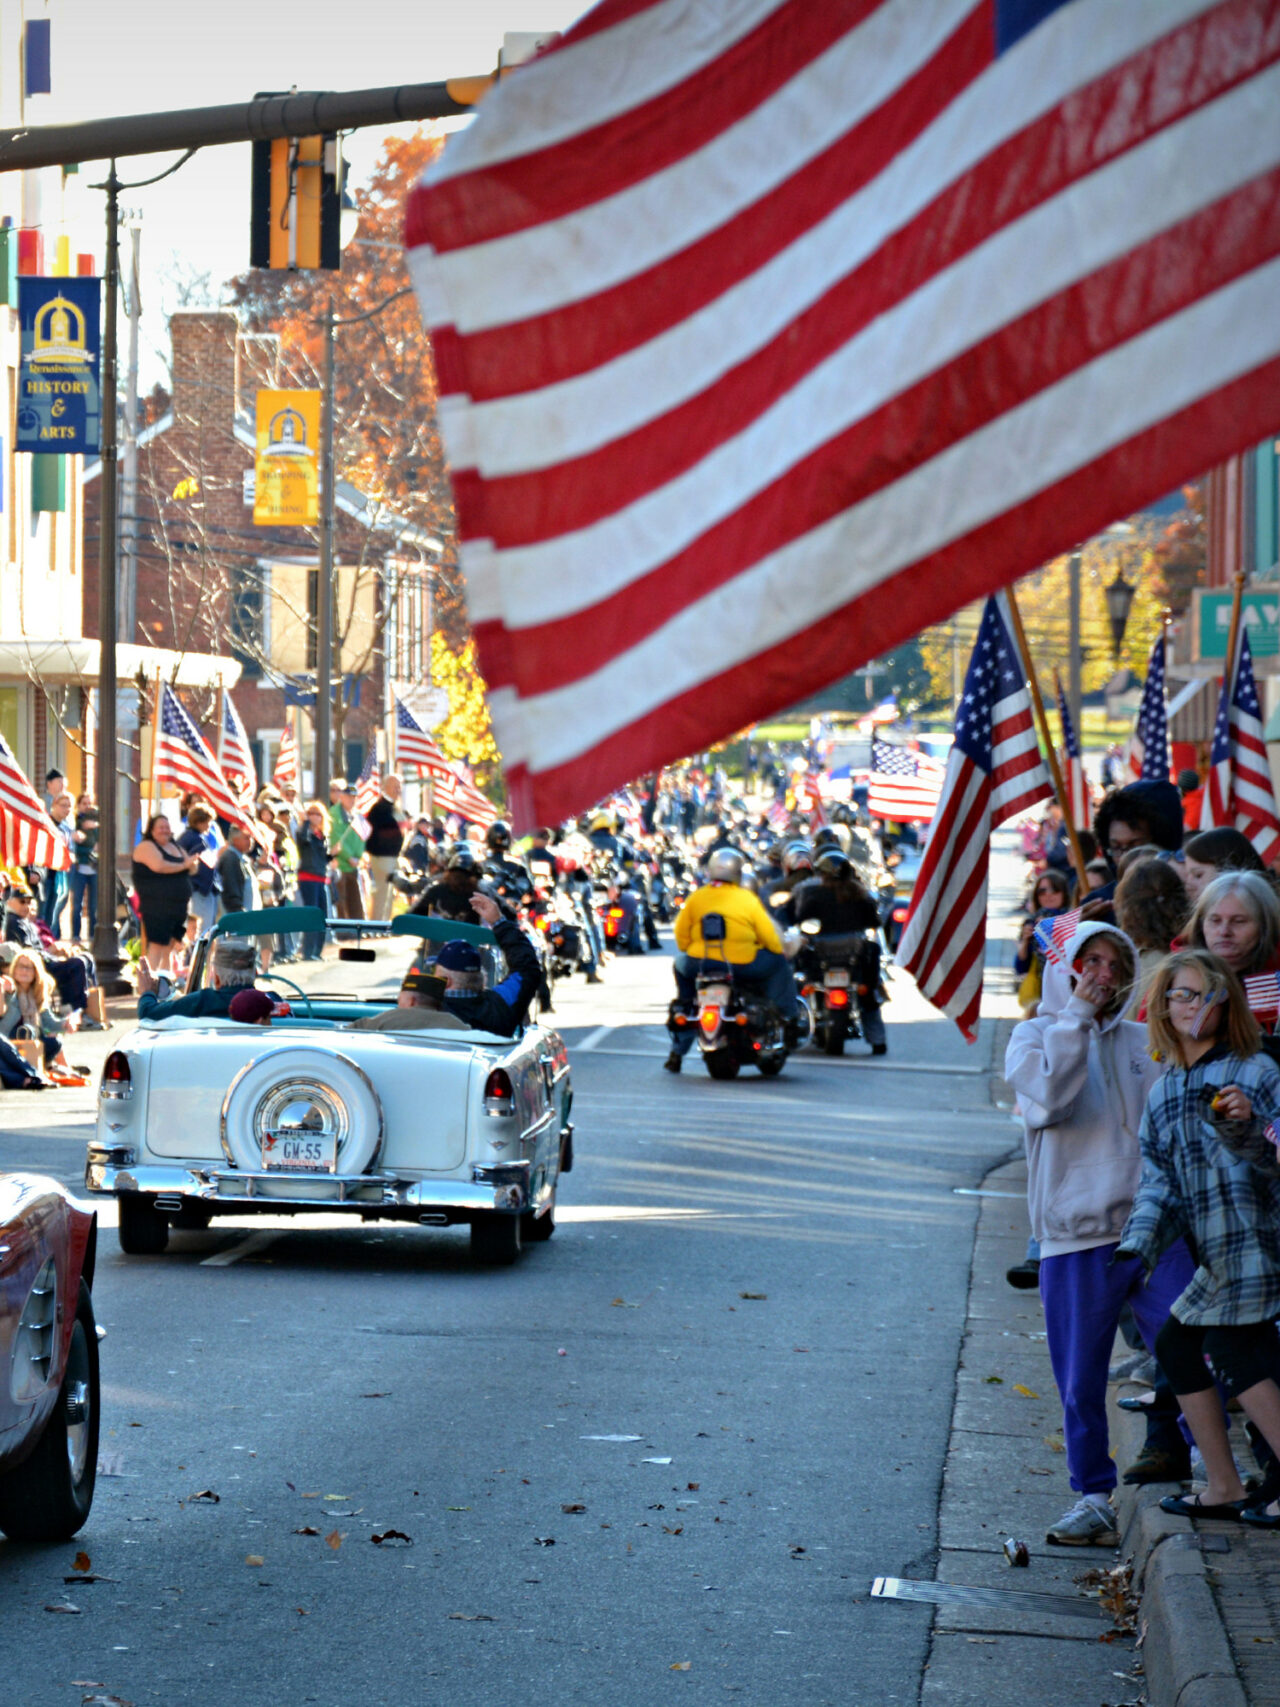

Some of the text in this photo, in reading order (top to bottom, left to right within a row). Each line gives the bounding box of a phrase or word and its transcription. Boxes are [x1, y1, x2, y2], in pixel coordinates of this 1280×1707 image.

[27, 380, 92, 395] HISTORY
[50, 397, 67, 418] &
[39, 425, 77, 440] ARTS
